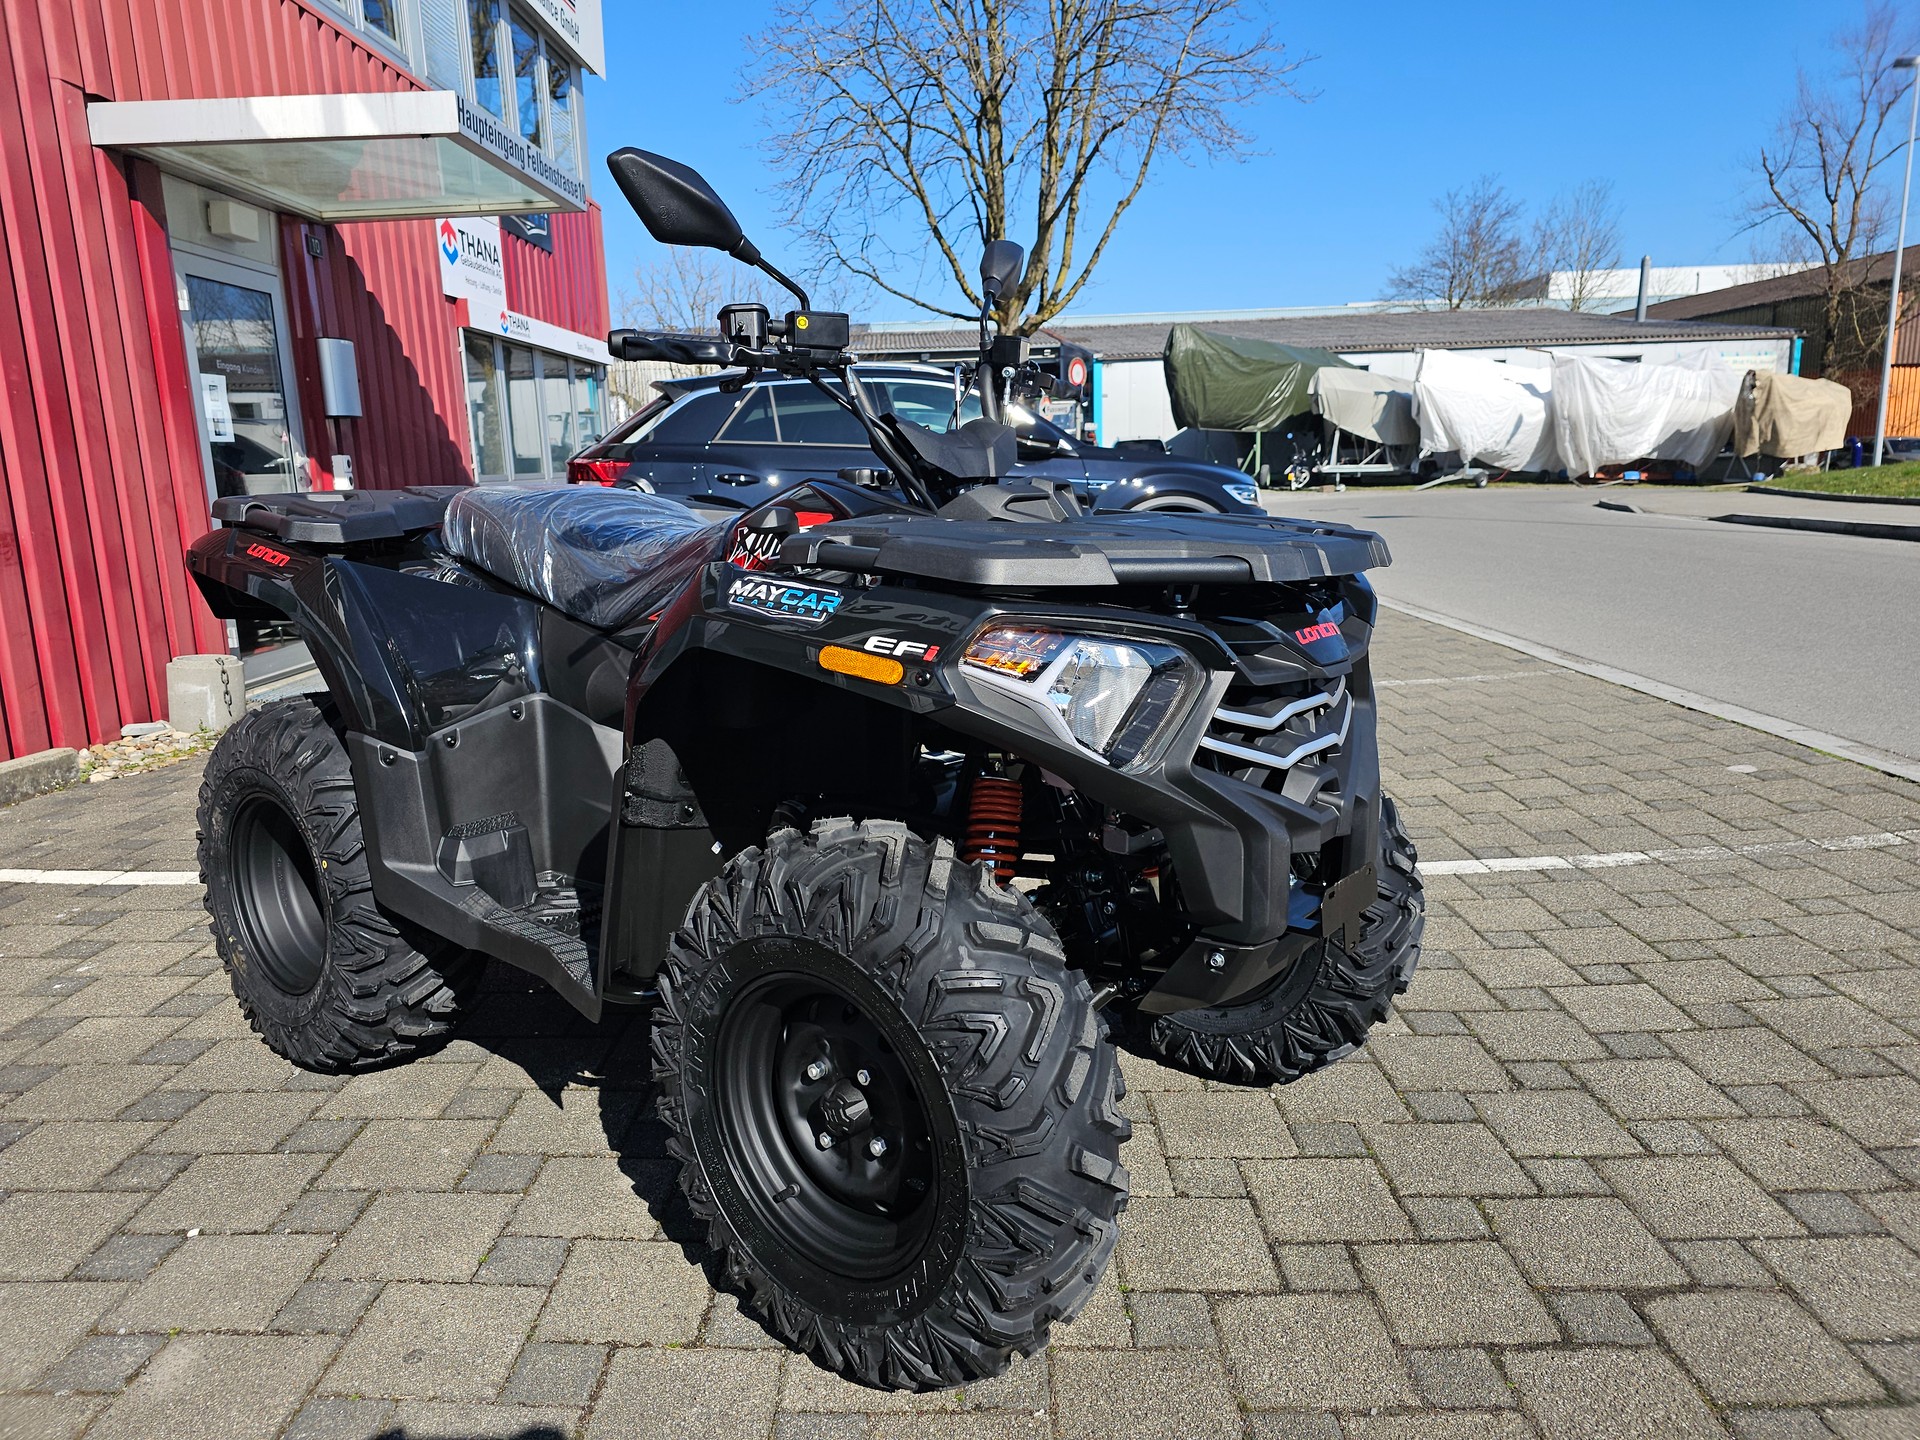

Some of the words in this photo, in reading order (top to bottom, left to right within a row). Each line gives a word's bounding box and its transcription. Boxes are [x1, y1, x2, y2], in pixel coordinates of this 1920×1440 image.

[560, 7, 580, 44] GmbH
[456, 95, 525, 170] Haupteingang
[526, 144, 578, 199] Felbenstrasse
[577, 182, 587, 205] 10
[311, 238, 321, 254] 10
[458, 228, 501, 268] THANA
[508, 314, 531, 333] THANA
[216, 359, 242, 374] Eingang
[241, 363, 265, 376] Kunden
[728, 580, 841, 613] MAYCAR
[736, 596, 821, 618] GARAGE
